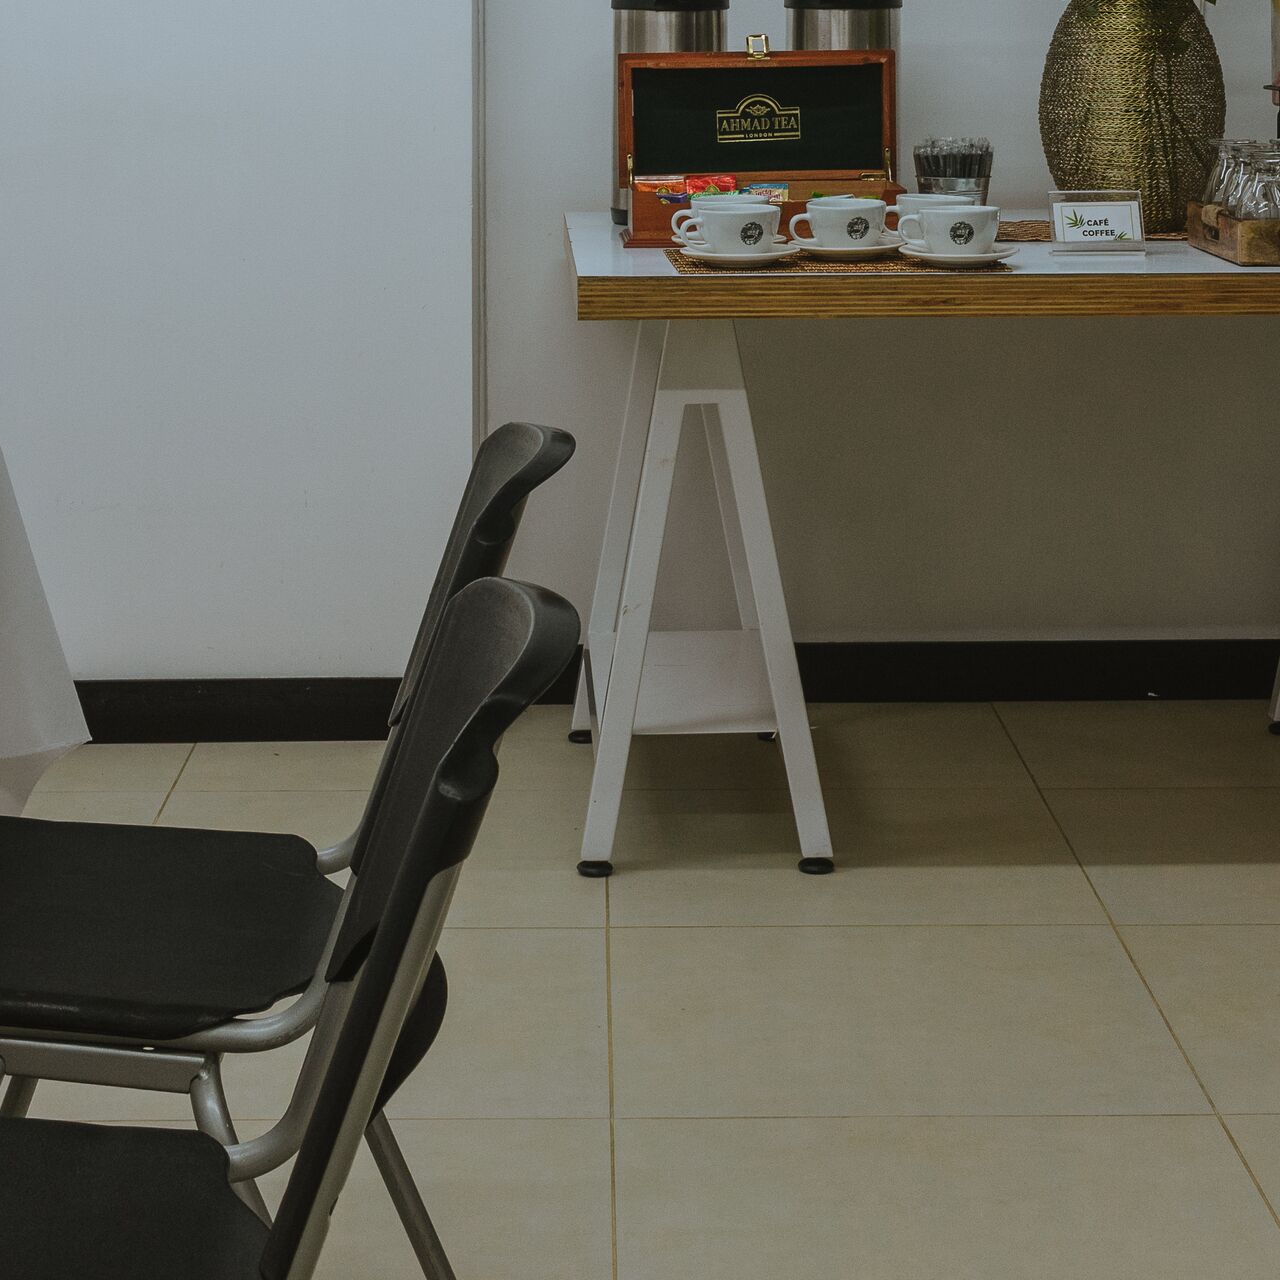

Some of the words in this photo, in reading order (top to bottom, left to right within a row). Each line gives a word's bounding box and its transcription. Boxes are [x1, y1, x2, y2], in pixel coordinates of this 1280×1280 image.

[720, 118, 771, 131] AHMAD
[772, 116, 798, 129] TEA
[1086, 217, 1110, 227] CAFÉ
[1082, 229, 1116, 237] COFFEE
